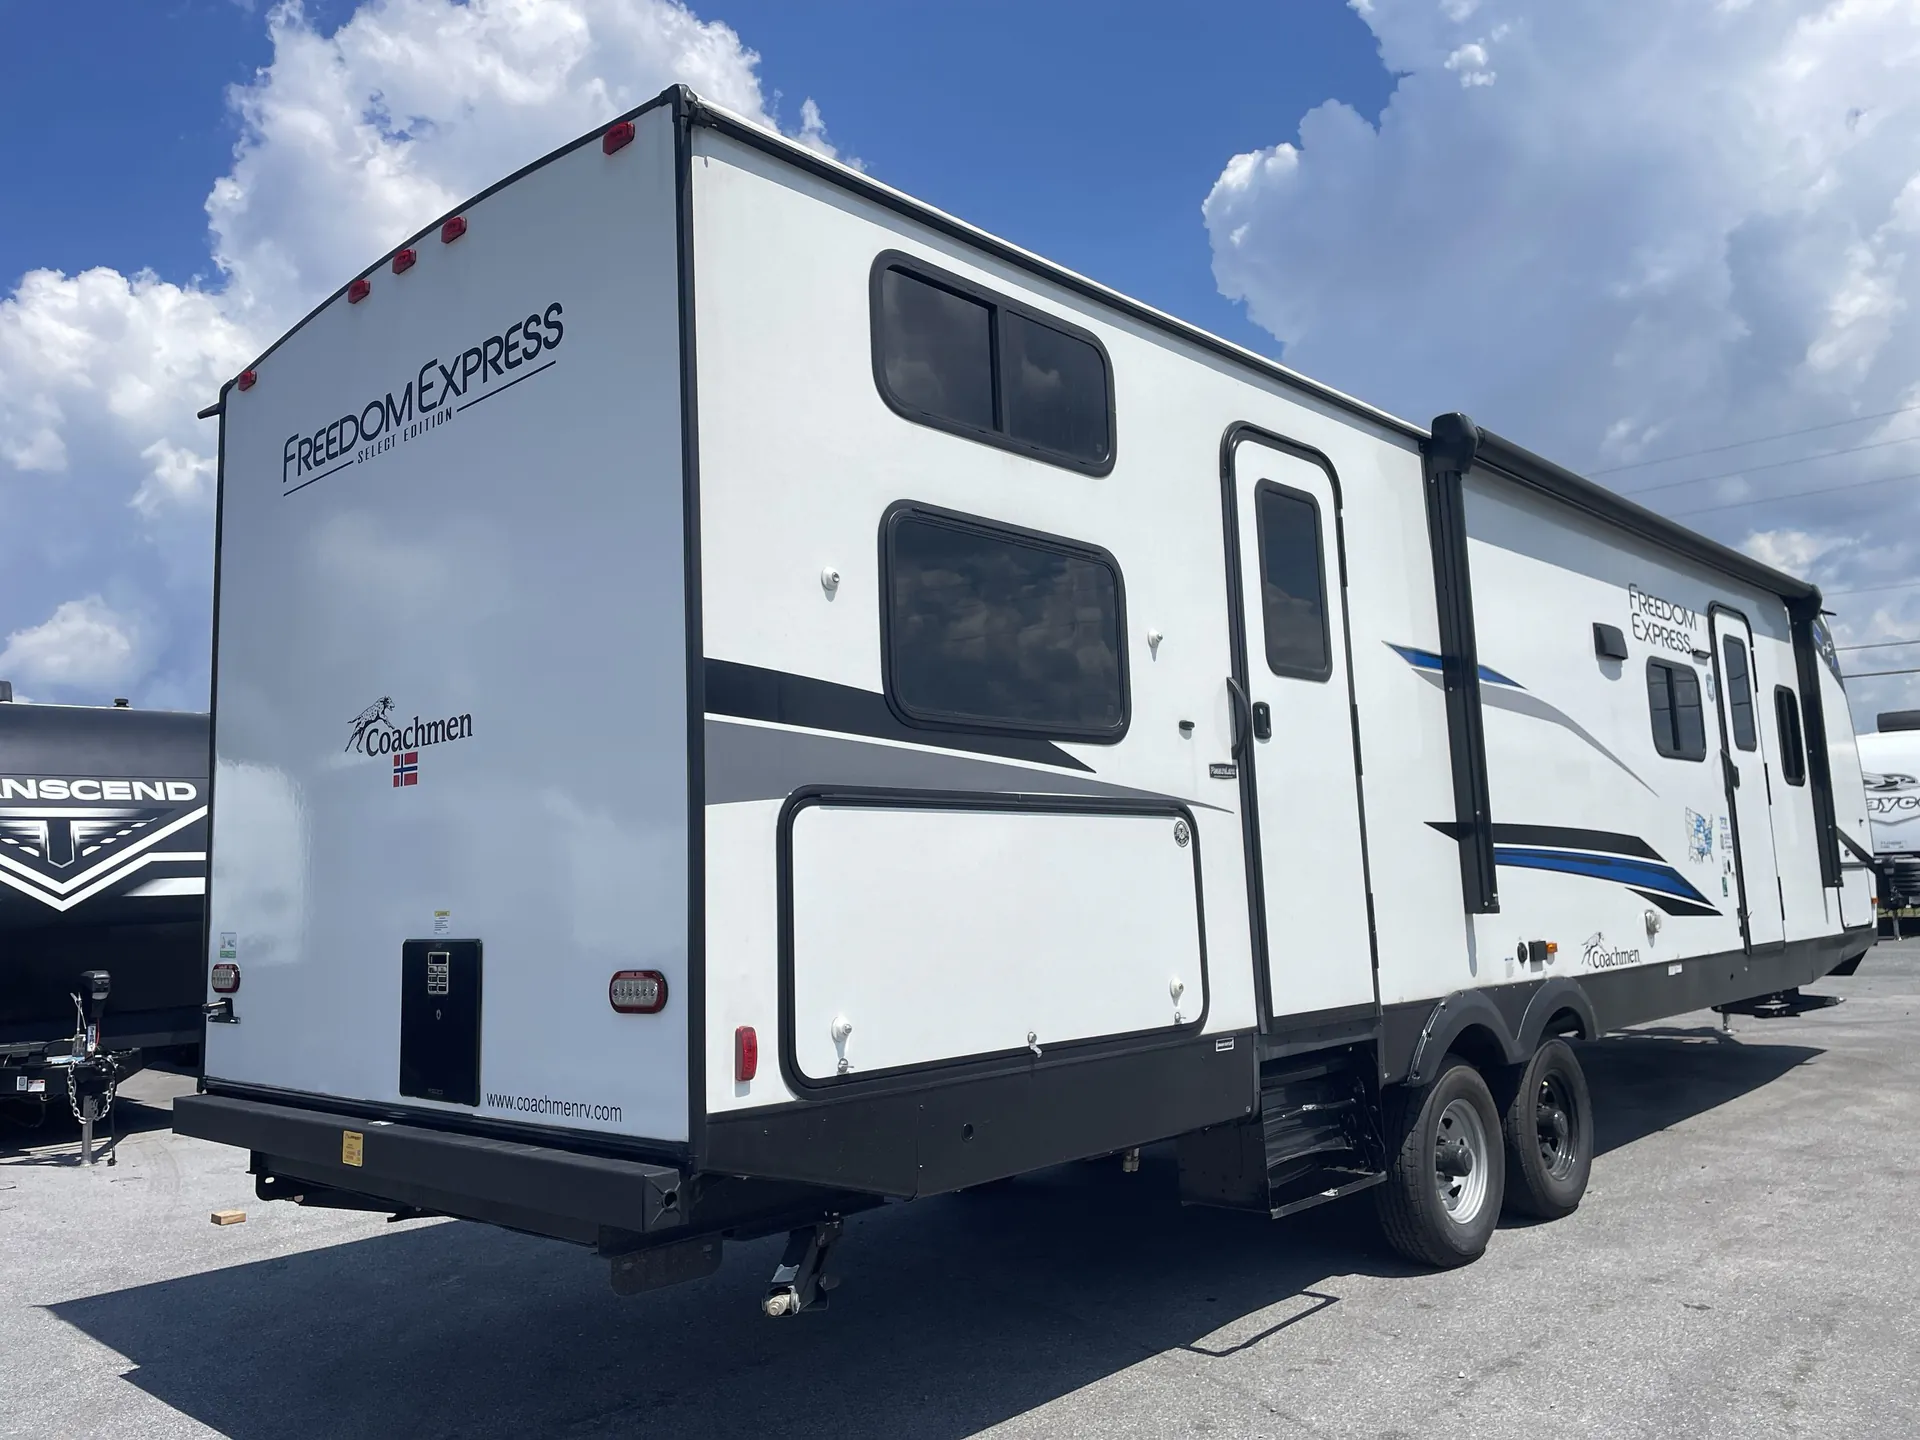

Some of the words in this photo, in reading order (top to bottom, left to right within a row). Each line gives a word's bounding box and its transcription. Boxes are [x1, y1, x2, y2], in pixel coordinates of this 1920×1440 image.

[283, 381, 413, 483] FREEDOM
[418, 302, 564, 414] EXPRESS
[357, 434, 397, 464] SELECT
[403, 406, 452, 442] EDITION
[1628, 583, 1698, 631] FREEDOM
[1631, 612, 1692, 654] EXPRESS
[365, 713, 473, 757] Coachmen
[0, 778, 197, 801] NSCEND
[1592, 947, 1640, 969] Coachmen
[486, 1092, 623, 1122] www.coachmenrv.com
